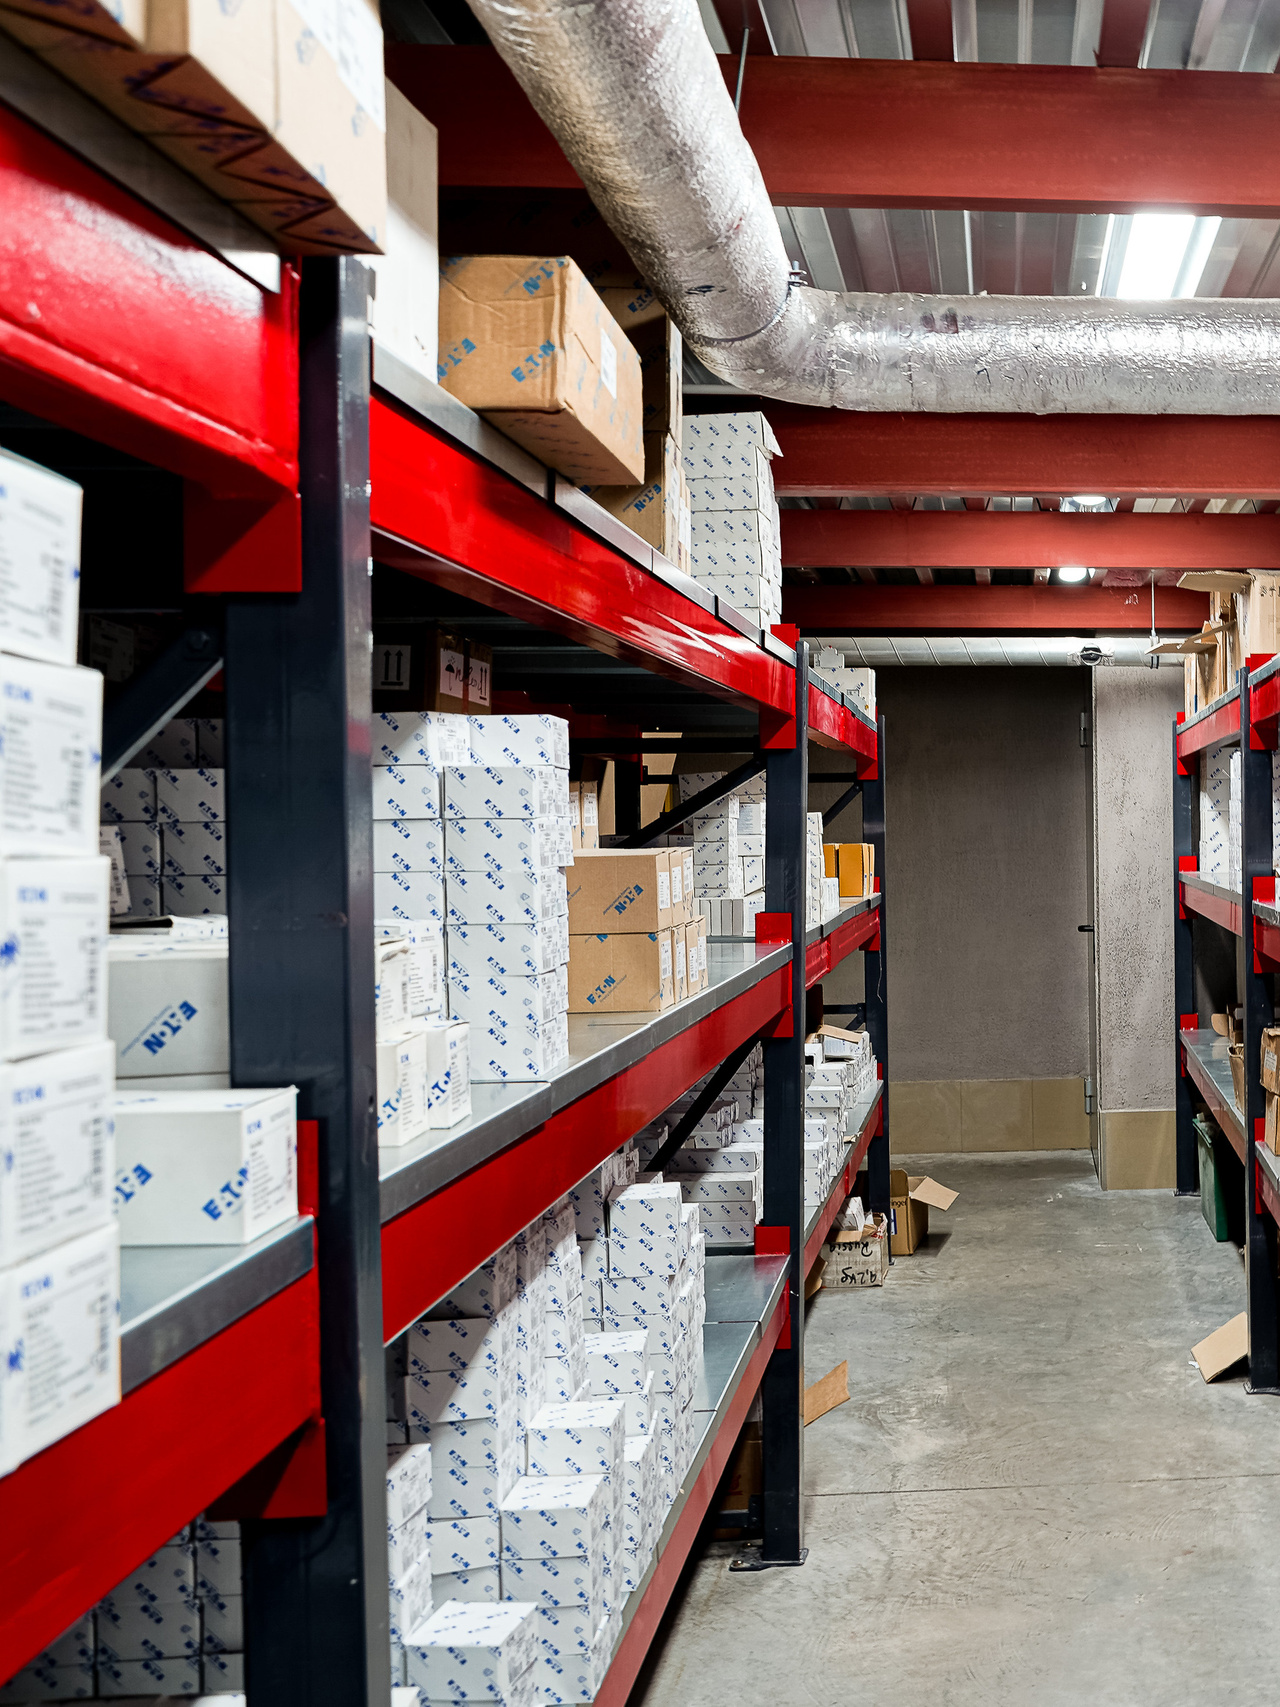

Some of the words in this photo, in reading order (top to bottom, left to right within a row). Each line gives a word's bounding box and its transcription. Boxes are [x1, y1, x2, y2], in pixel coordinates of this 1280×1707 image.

[511, 339, 556, 383] EATON
[633, 483, 662, 513] EATON
[614, 884, 644, 915] EATON
[586, 975, 616, 1005] EATON
[142, 1000, 198, 1056] EATON
[829, 1241, 873, 1257] Russia
